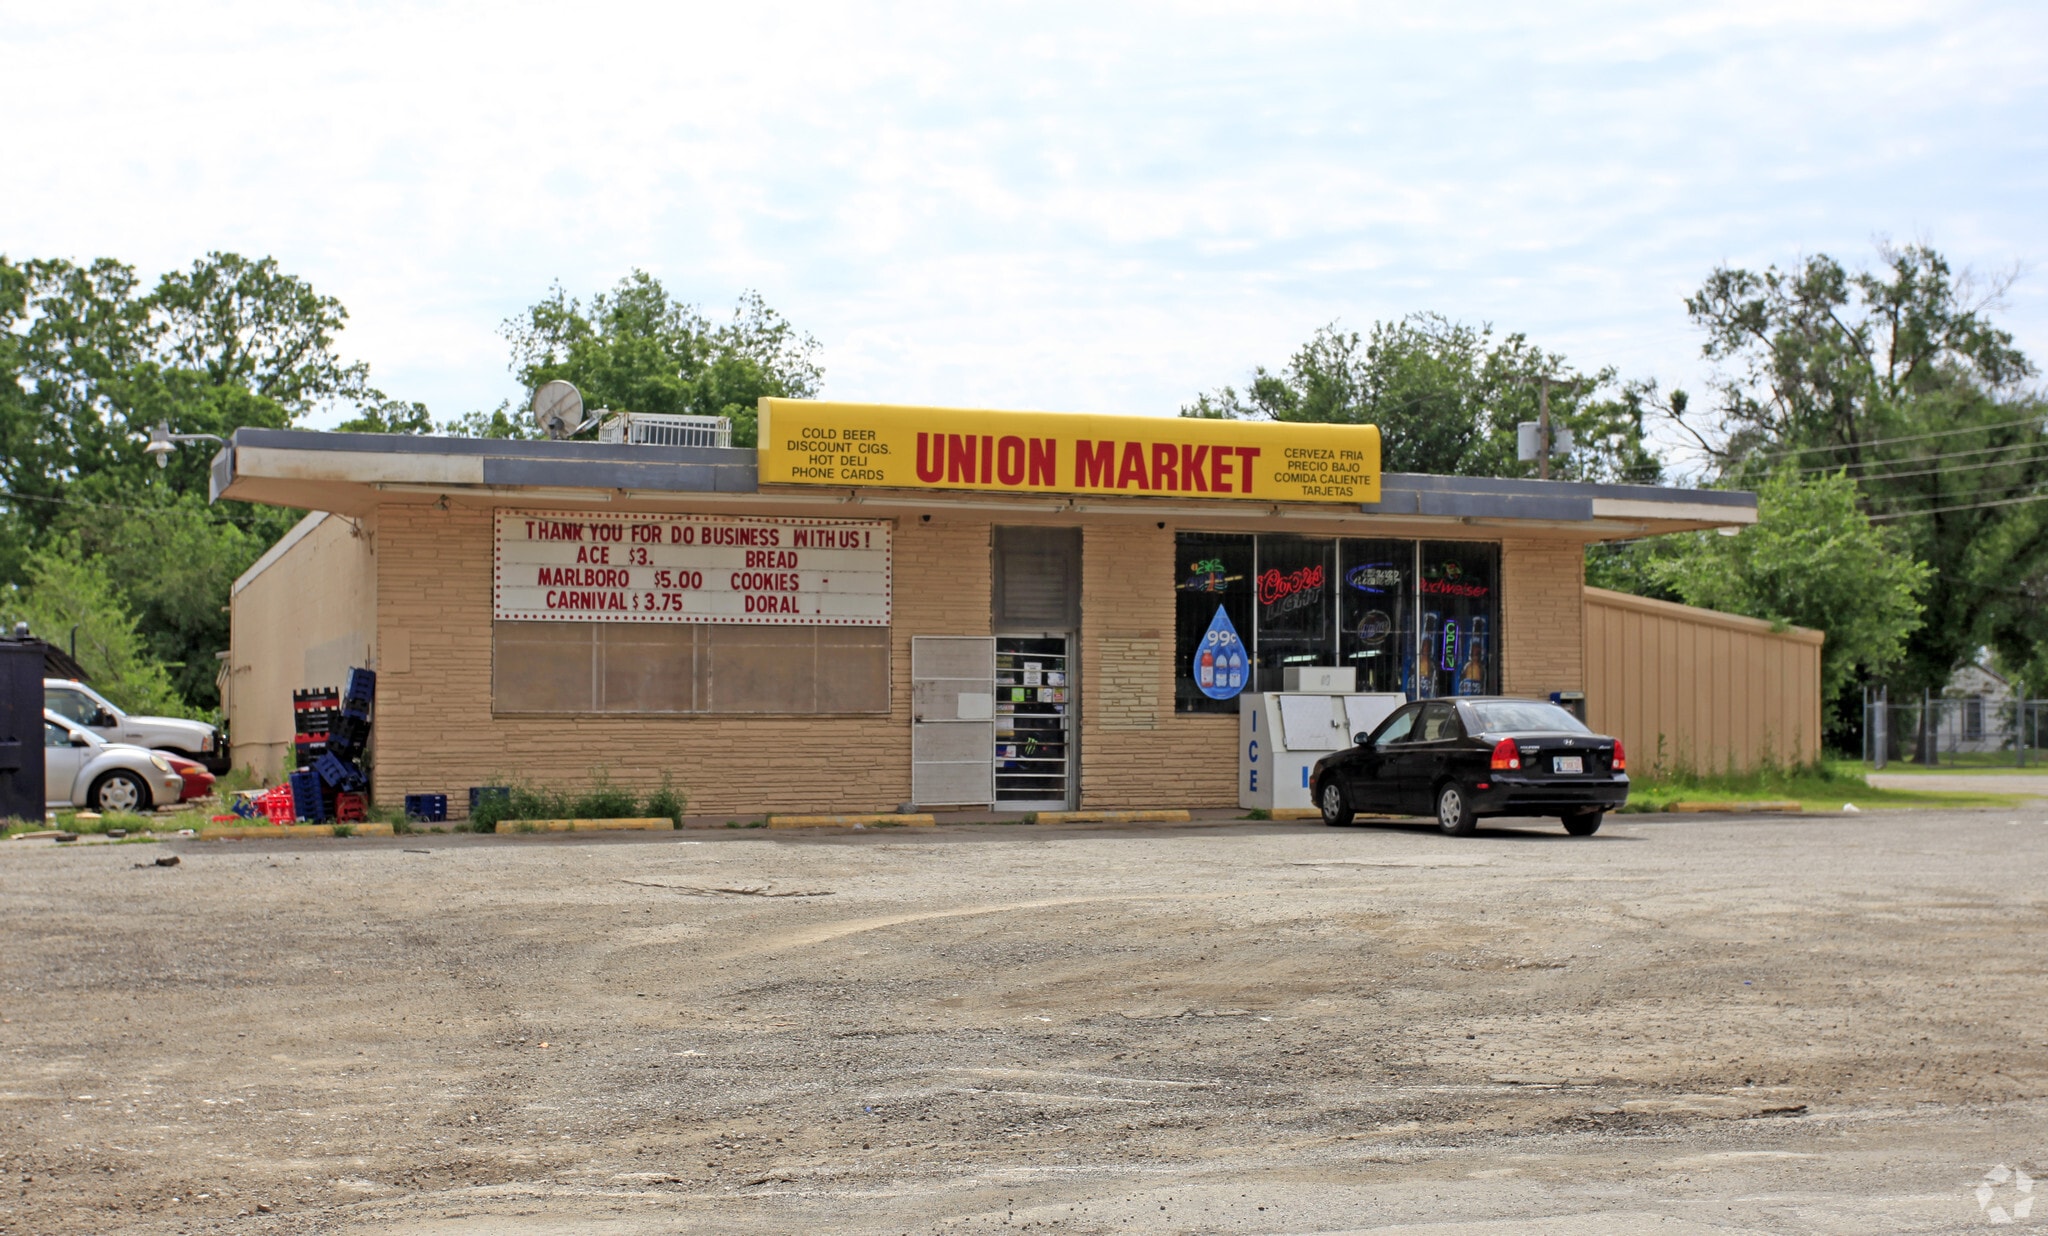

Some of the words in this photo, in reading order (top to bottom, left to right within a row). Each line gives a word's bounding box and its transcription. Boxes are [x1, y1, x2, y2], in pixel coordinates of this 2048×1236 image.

[801, 427, 837, 440] COLD
[842, 429, 876, 441] BEER
[787, 440, 852, 453] DISCOUNT
[857, 443, 892, 455] CIGS.
[1284, 447, 1335, 460] CERVEZA
[1340, 450, 1364, 461] FRIA
[809, 454, 835, 465] HOT
[840, 455, 867, 466] DELI
[917, 432, 1057, 487] UNION
[1074, 440, 1261, 494] MARKET
[1287, 460, 1328, 472] PRECIO
[1332, 462, 1360, 473] BAJO
[792, 466, 835, 479] PHONE
[841, 468, 884, 481] CARDS
[1274, 472, 1317, 483] COMIDA
[1320, 473, 1371, 485] CALIENTE
[1302, 485, 1353, 497] TARJETAS
[526, 521, 584, 541] THANK
[589, 523, 623, 542] YOU
[631, 525, 662, 543] FOR
[671, 526, 695, 545] DO
[702, 527, 780, 546] BUSINESS
[794, 529, 836, 548] WITH
[577, 545, 610, 564] ACE
[746, 551, 798, 569] BREAD
[538, 567, 629, 588] MARLBORO
[654, 570, 703, 589] $5.00
[731, 572, 799, 591] COOKIES
[546, 590, 628, 610] CARNIVAL
[745, 595, 800, 613] DORAL
[1248, 710, 1259, 793] ICE
